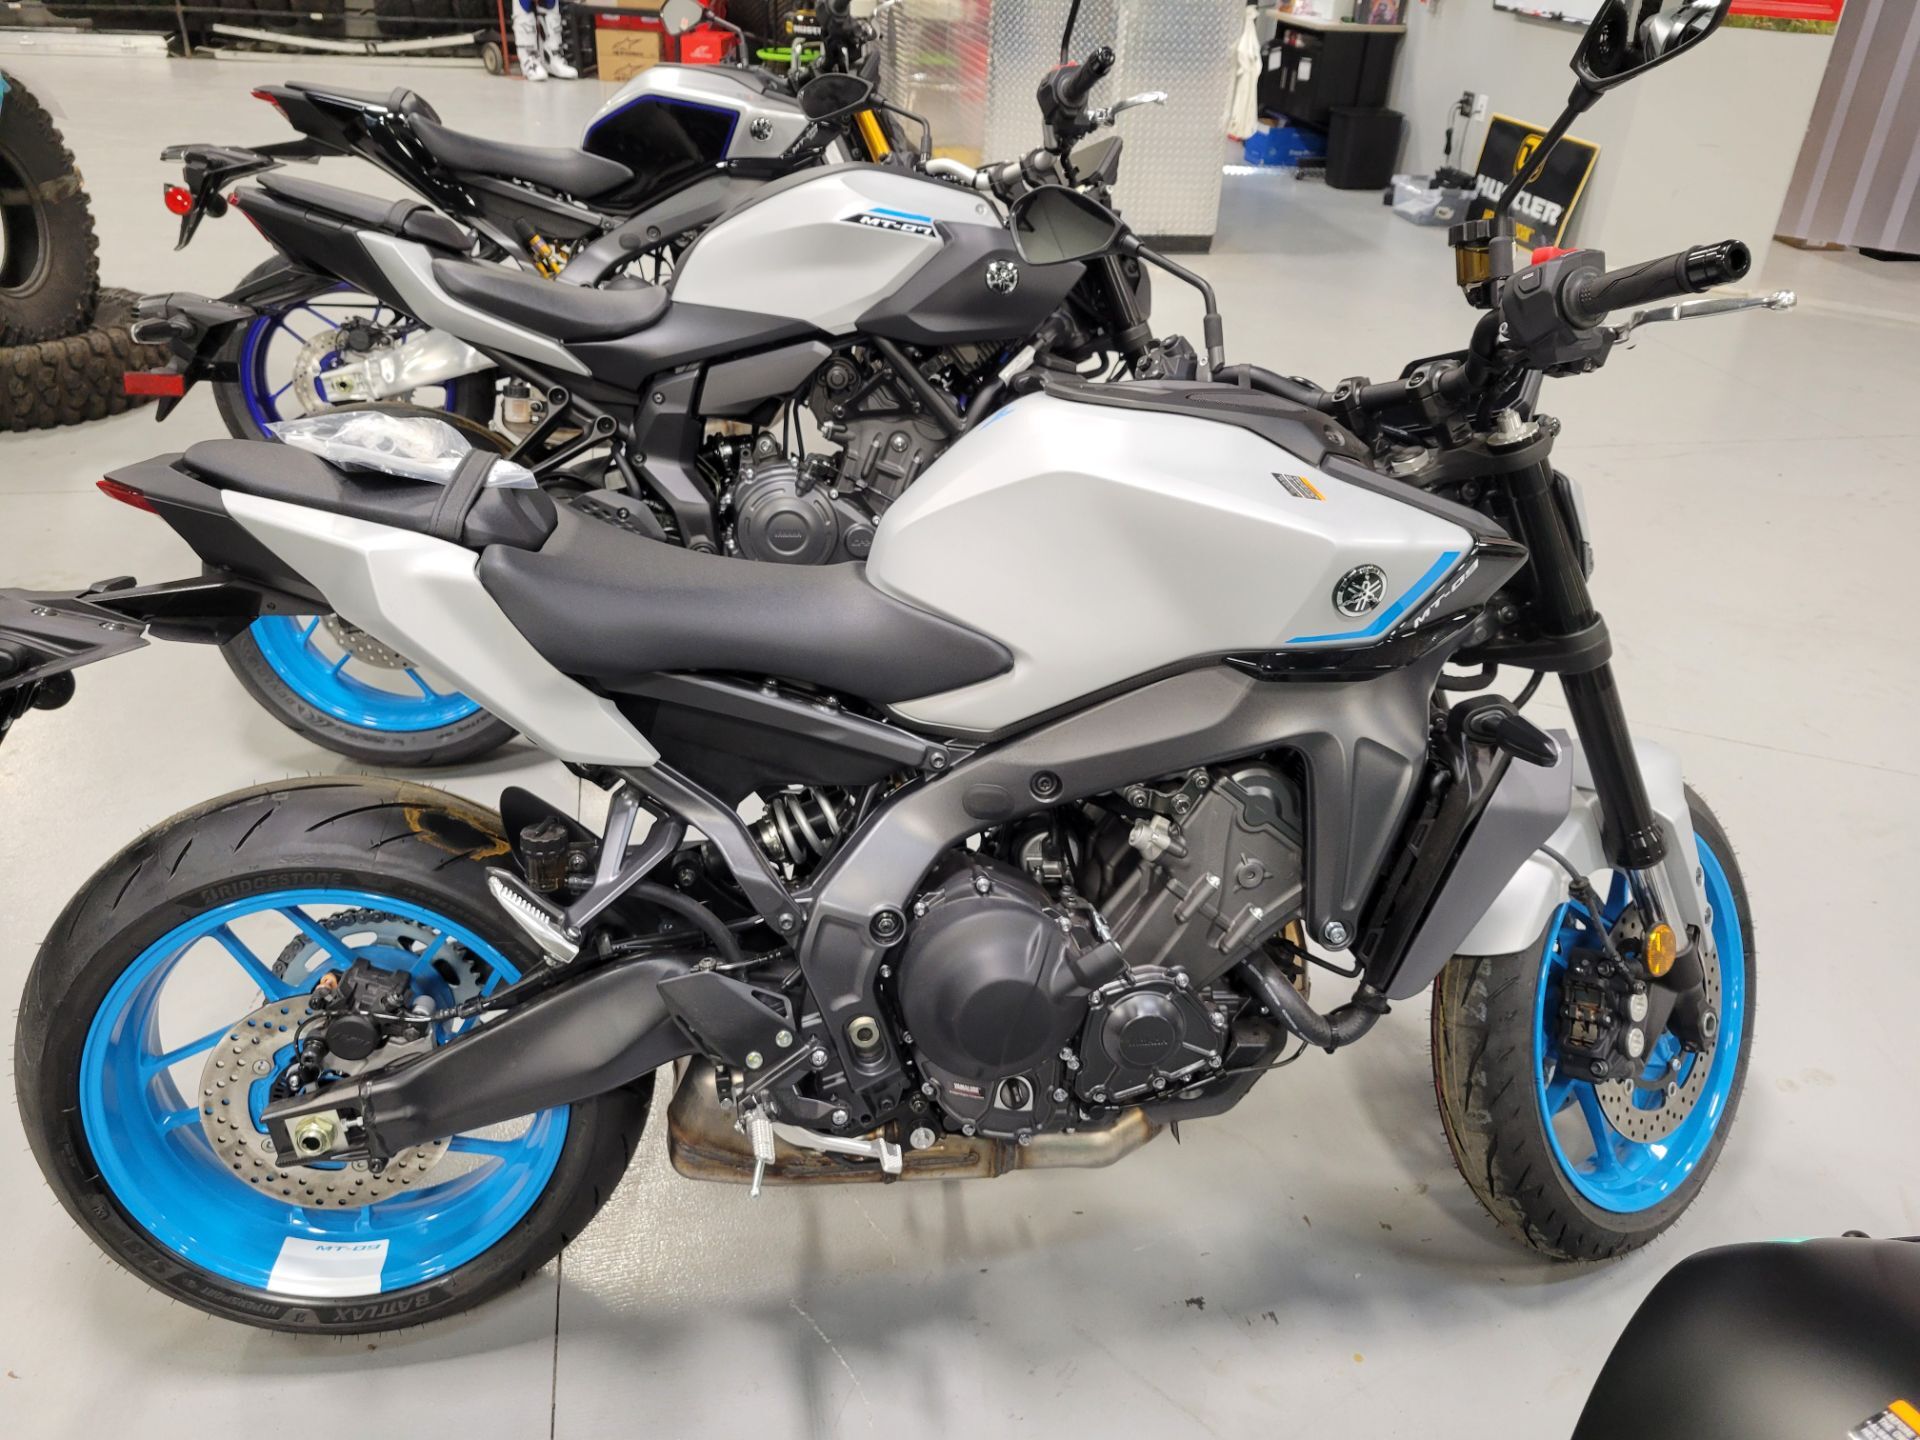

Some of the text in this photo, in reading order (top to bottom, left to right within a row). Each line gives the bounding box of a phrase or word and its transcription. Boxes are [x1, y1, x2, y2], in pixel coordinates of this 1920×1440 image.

[1475, 173, 1563, 226] HUTLER
[859, 215, 934, 236] MT-07
[202, 872, 342, 903] BRIDGESTONE
[315, 1243, 382, 1252] MT-09
[333, 1292, 432, 1322] BATTLAX
